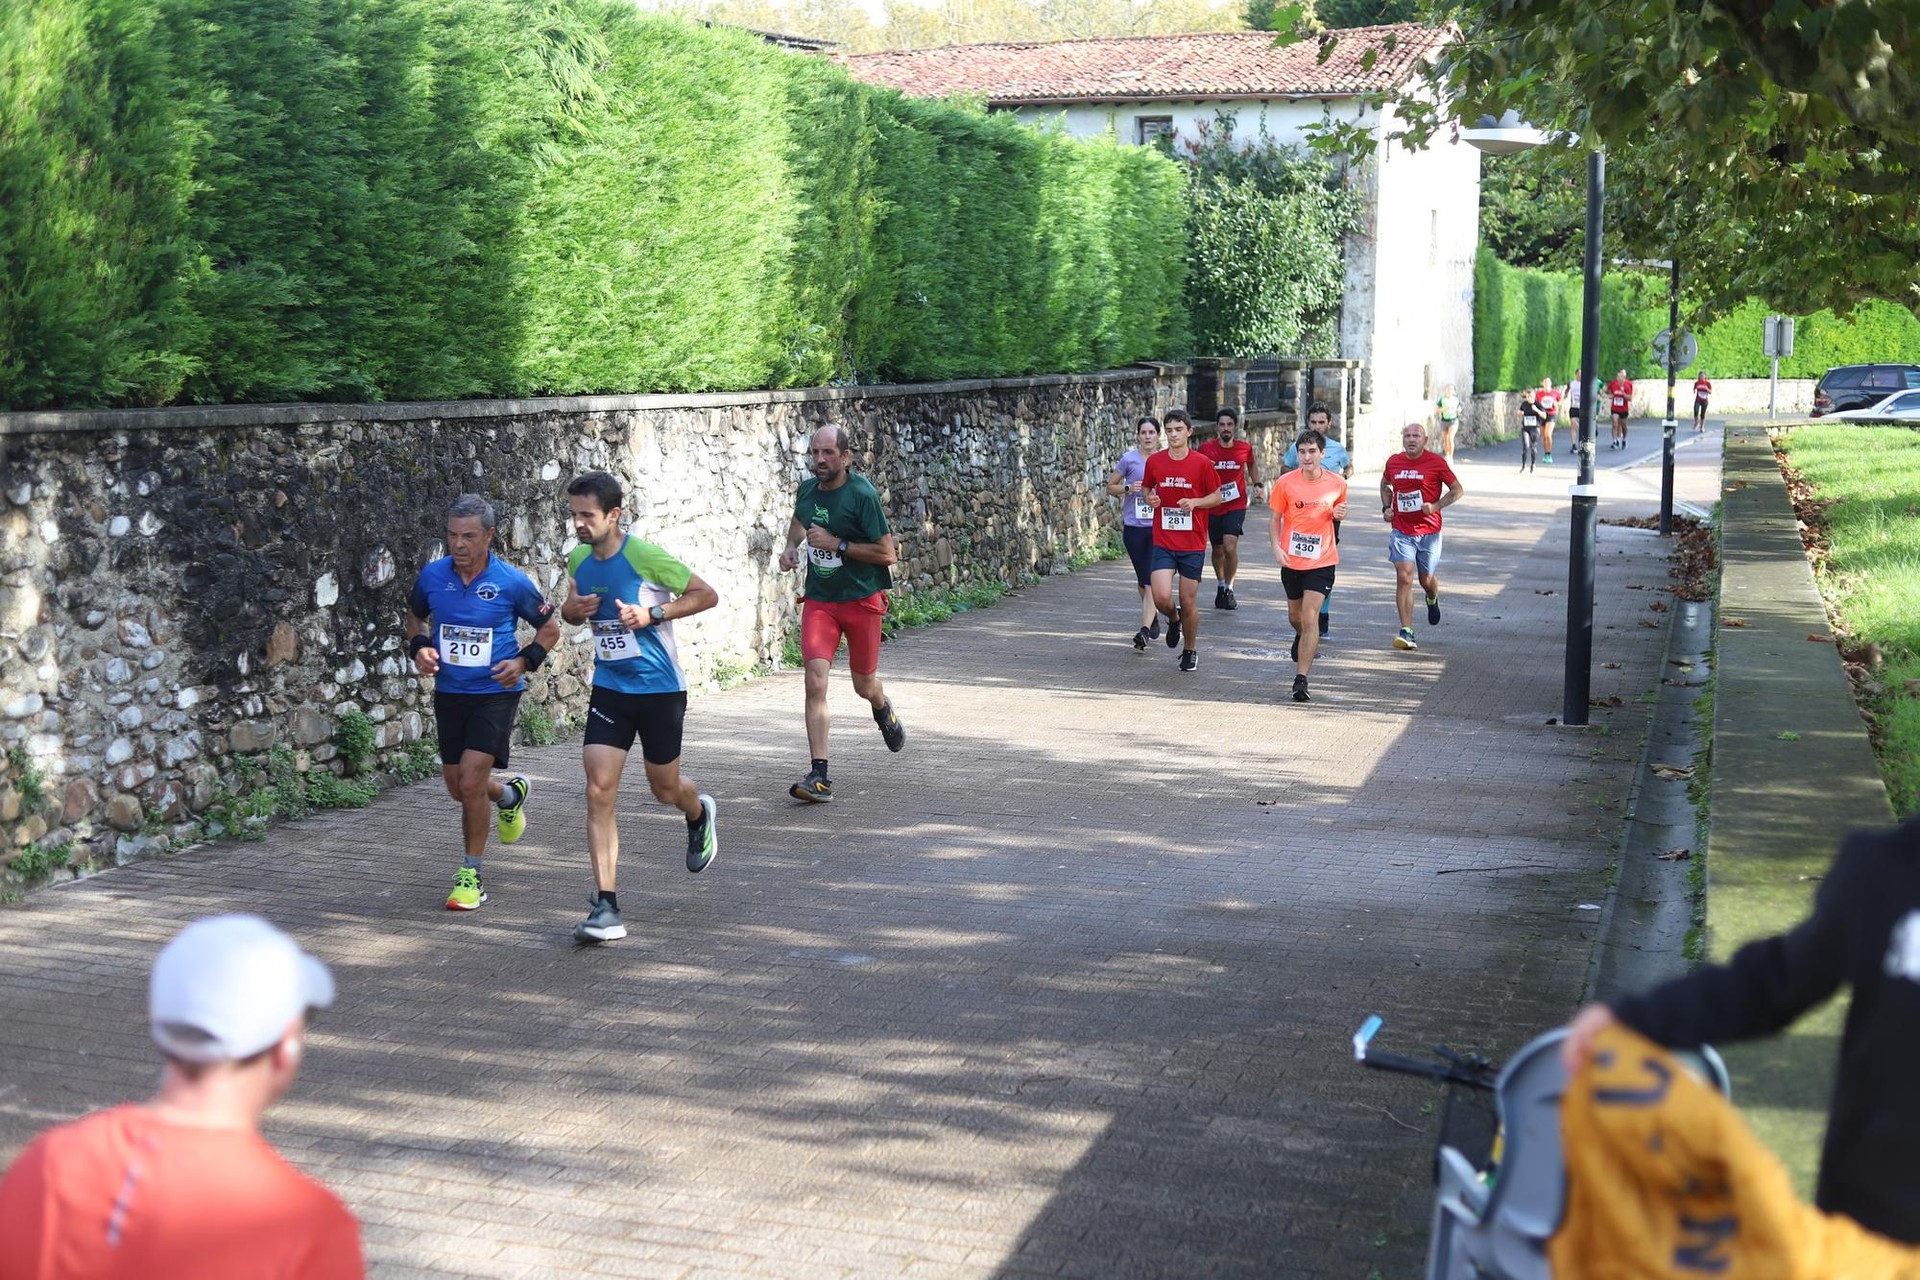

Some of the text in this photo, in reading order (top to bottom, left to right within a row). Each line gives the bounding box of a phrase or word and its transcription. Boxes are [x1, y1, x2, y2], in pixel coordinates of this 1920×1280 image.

[1401, 500, 1416, 508] 751
[1168, 516, 1185, 525] 281
[1295, 542, 1314, 552] 430
[812, 548, 833, 560] 493
[600, 636, 626, 650] 455
[450, 642, 480, 656] 210
